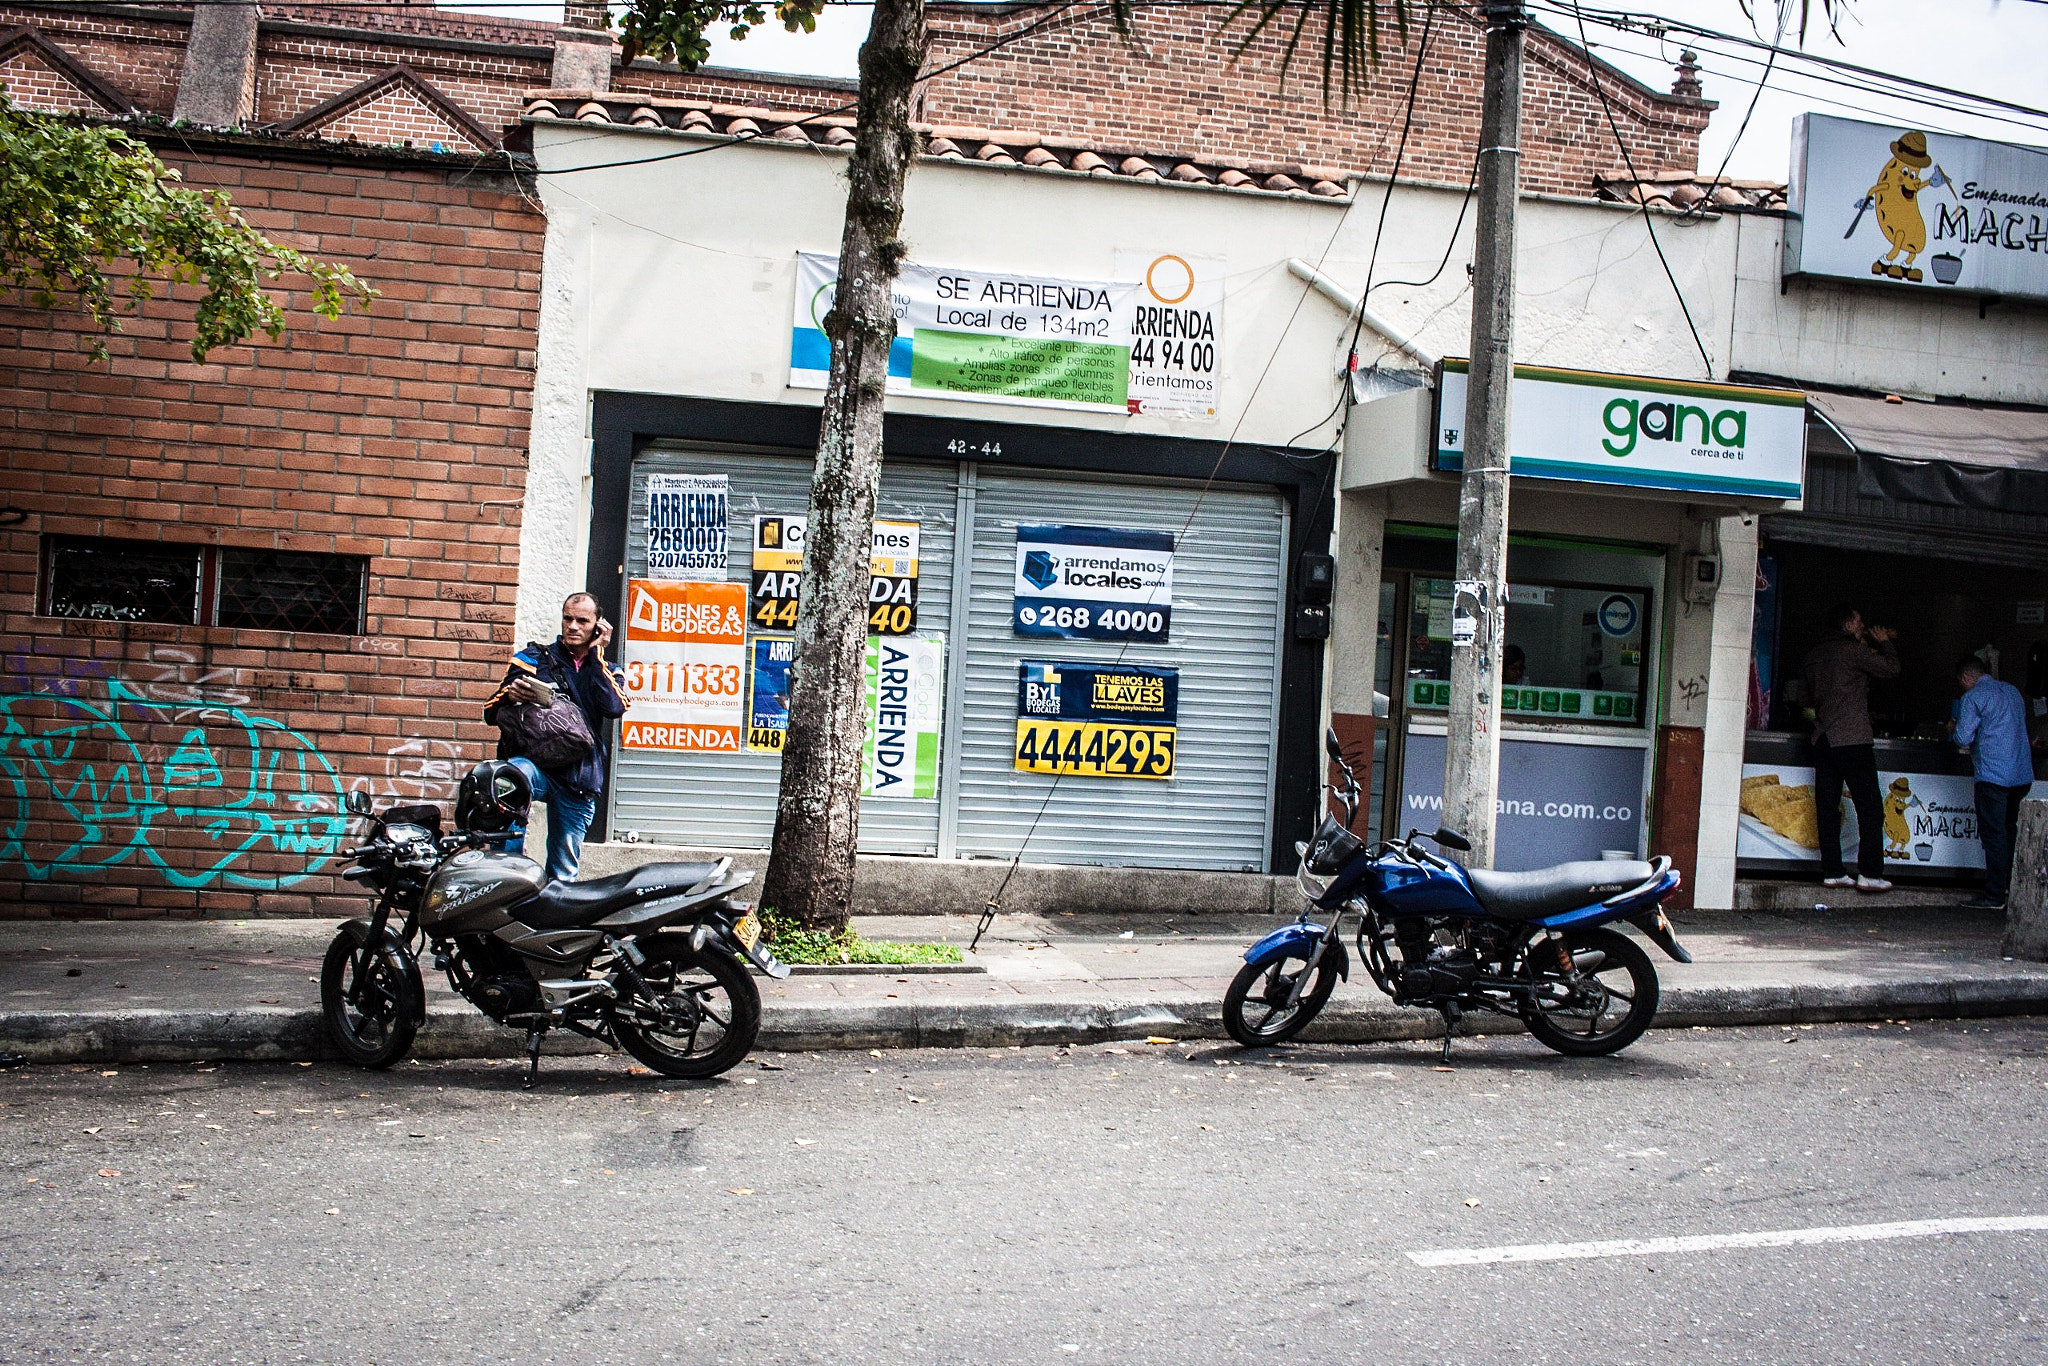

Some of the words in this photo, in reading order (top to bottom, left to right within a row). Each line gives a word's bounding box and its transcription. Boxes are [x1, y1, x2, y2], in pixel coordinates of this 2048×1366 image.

[1961, 182, 2048, 208] Empanada
[936, 275, 971, 301] SE
[980, 280, 1113, 313] ARRIENDA
[936, 305, 991, 328] Local
[1001, 311, 1028, 331] de
[1040, 313, 1110, 338] 134m2
[1011, 337, 1062, 352] Excelente
[1065, 342, 1116, 357] ubicación
[1162, 340, 1184, 370] 94
[1191, 342, 1214, 372] 00
[963, 358, 1006, 372] Amplias
[1009, 363, 1040, 374] zonas
[1044, 364, 1060, 375] sin
[1064, 368, 1115, 380] columnas
[989, 348, 1010, 360] Alto
[1014, 349, 1045, 363] tráfico
[1049, 353, 1063, 364] de
[1067, 356, 1116, 369] personas
[947, 380, 1026, 397] Recientemente
[1030, 387, 1046, 398] fue
[1050, 390, 1113, 403] remodelado
[969, 370, 1002, 383] Zonas
[1006, 373, 1020, 385] de
[1024, 376, 1069, 389] parqueo
[1072, 379, 1114, 392] flexibles
[1601, 397, 1747, 458] gana
[947, 438, 966, 454] 42
[981, 441, 1002, 456] 44
[1690, 448, 1720, 458] cerca
[1722, 449, 1735, 460] de
[1737, 450, 1744, 461] ti
[649, 493, 727, 528] ARRIENDA
[649, 527, 727, 553] 2680007
[649, 552, 727, 569] 3207455732
[1064, 556, 1166, 574] arrendamos
[1064, 568, 1166, 590] locales.com
[661, 602, 721, 621] BIENES
[726, 605, 742, 624] &
[1039, 605, 1090, 629] 268
[1097, 608, 1163, 633] 4000
[660, 618, 743, 636] BODEGAS
[627, 660, 740, 696] 3111333
[1094, 674, 1143, 686] TENEMOS
[1145, 677, 1164, 687] LAS
[628, 695, 739, 708] www.bienesybodegas.com
[1026, 699, 1061, 708] BODEGAS
[1095, 685, 1162, 704] LLAVES
[875, 644, 909, 790] ARRIENDA
[1032, 706, 1060, 714] LOCALES
[767, 718, 789, 729] ISAB
[625, 725, 737, 749] ARRIENDA
[749, 729, 781, 748] 448
[1018, 727, 1172, 775] 4444295
[1408, 794, 1632, 821] wwana.com.co
[1927, 801, 1977, 814] Empanada
